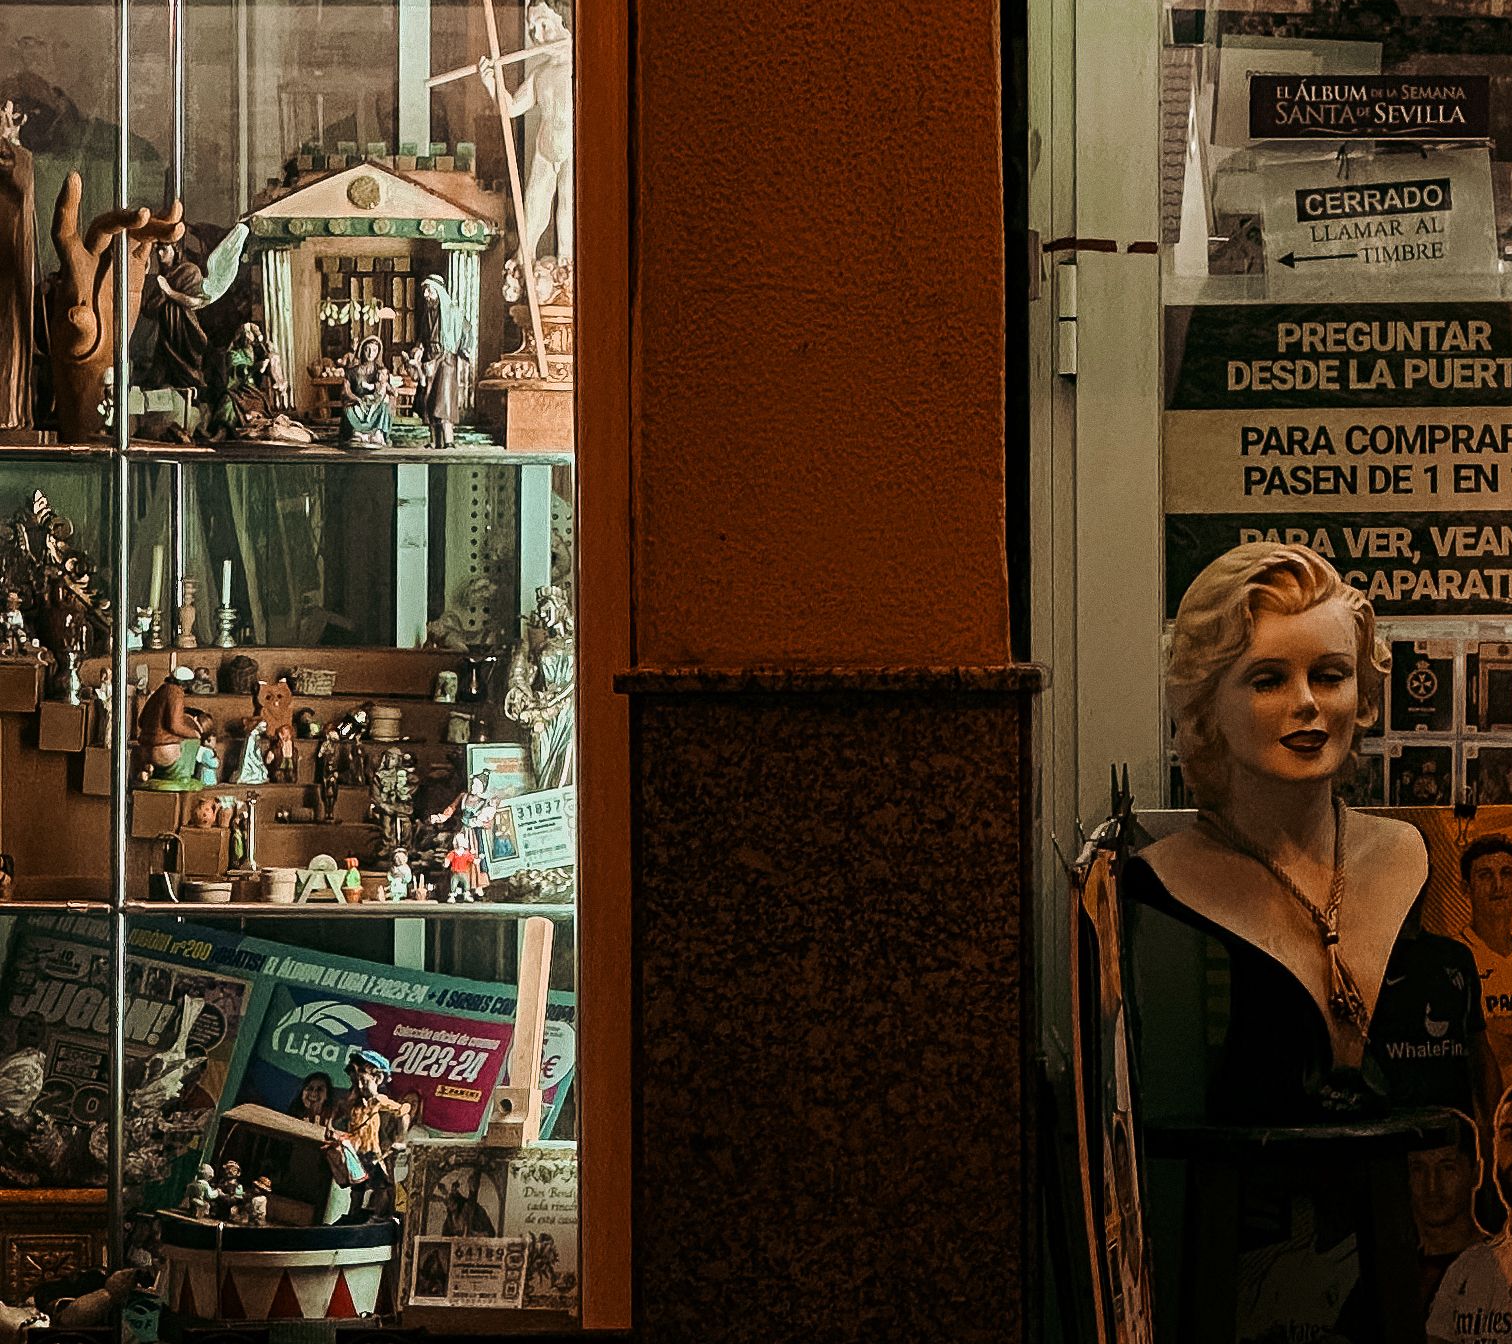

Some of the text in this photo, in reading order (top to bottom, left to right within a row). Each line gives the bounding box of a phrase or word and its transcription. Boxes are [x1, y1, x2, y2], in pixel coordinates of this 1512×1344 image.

[1276, 86, 1291, 99] EL
[1293, 79, 1368, 102] ÁLBUM
[1401, 84, 1467, 101] SEMANA
[1275, 102, 1357, 125] SANTA
[1373, 102, 1467, 125] SEVILLA
[1304, 184, 1443, 216] CERRADO
[1310, 216, 1445, 243] LLAMAR AL
[1359, 242, 1444, 265] TIMBRE
[1277, 320, 1492, 353] PREGUNTAR
[1226, 359, 1341, 392] DESDE
[1349, 358, 1396, 390] LA
[1240, 425, 1336, 456] PARA
[1243, 464, 1358, 496] PASEN
[1368, 464, 1414, 494] DE
[1422, 464, 1439, 494] 1
[1453, 464, 1499, 493] EN
[1343, 527, 1421, 565] VER,
[284, 1032, 340, 1064] Liga
[391, 1041, 490, 1084] 2023-24
[1386, 1039, 1464, 1060] WhaleFin
